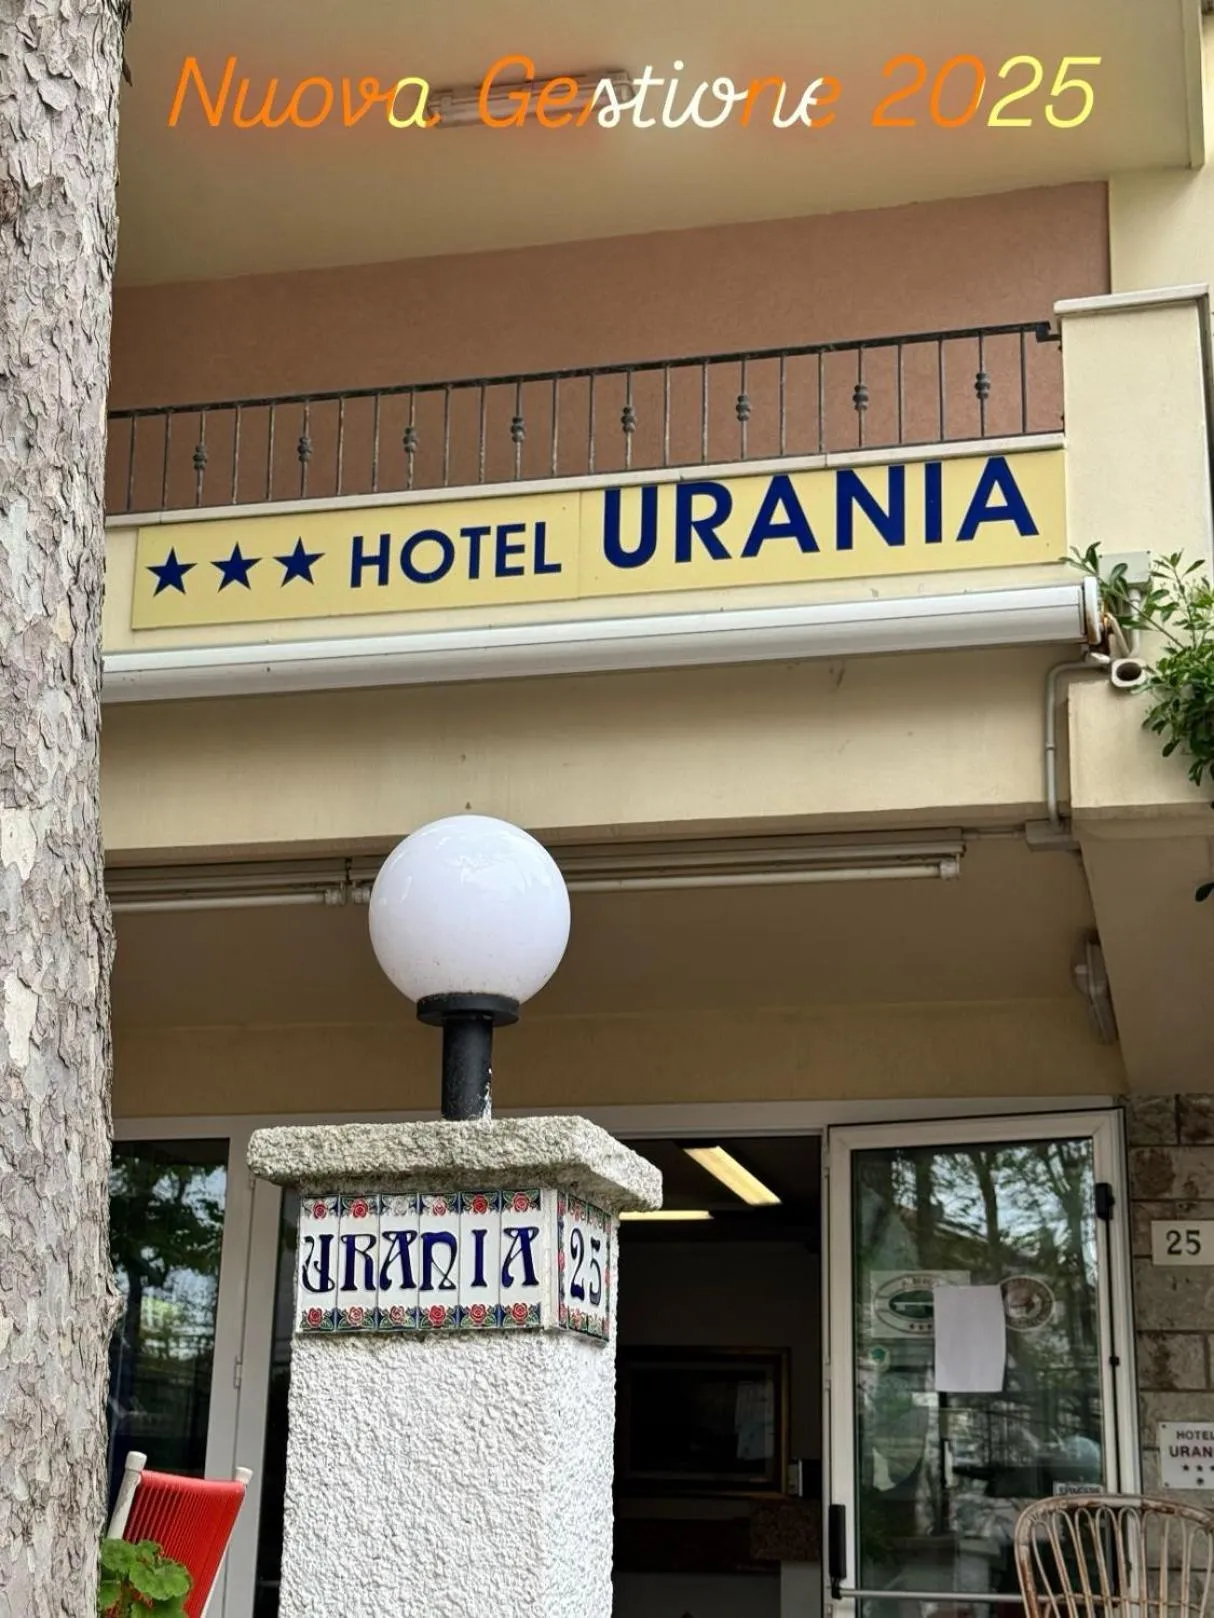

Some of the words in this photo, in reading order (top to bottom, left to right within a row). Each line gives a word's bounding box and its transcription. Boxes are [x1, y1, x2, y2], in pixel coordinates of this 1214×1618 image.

[350, 521, 562, 588] HOTEL
[603, 456, 1039, 569] URANIA
[301, 1226, 540, 1293] URANIA
[570, 1227, 601, 1306] 25
[1166, 1229, 1202, 1256] 25
